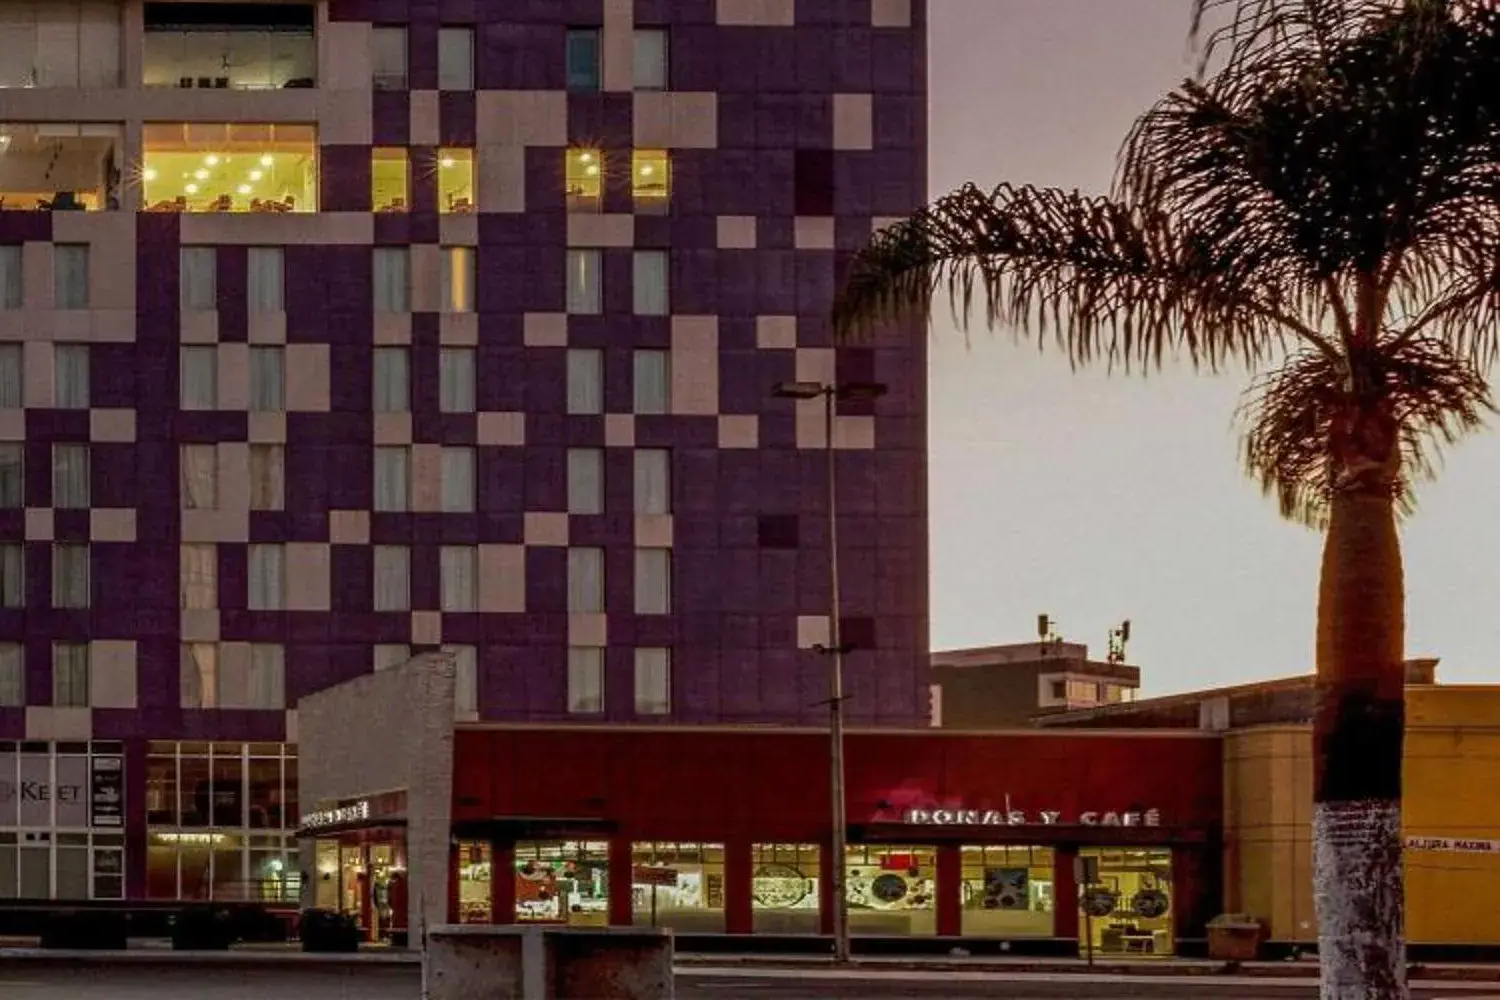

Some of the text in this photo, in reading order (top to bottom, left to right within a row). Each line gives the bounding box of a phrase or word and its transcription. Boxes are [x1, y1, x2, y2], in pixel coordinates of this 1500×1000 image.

[909, 807, 1161, 827] DONAS Y CAFÉ
